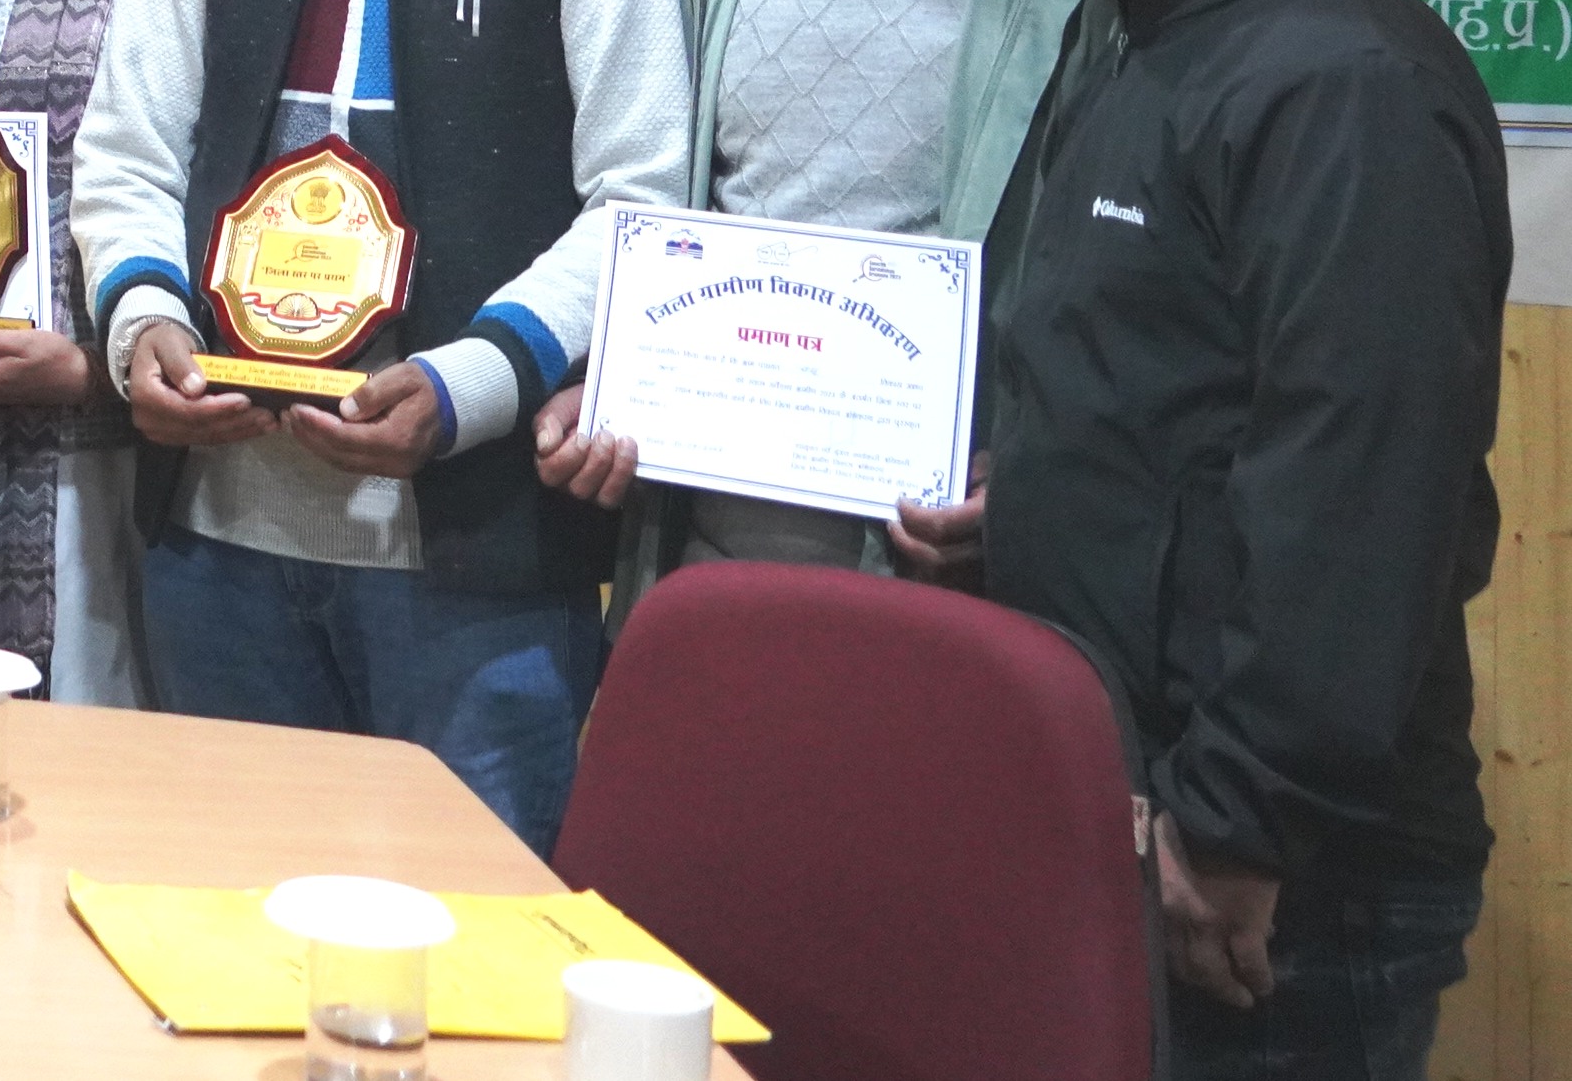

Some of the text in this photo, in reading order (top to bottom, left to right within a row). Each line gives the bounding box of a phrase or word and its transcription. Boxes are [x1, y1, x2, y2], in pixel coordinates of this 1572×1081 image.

[645, 275, 922, 361] जिला ग्रामीण विकास अभिकरण
[738, 326, 824, 352] प्रमाण पत्र
